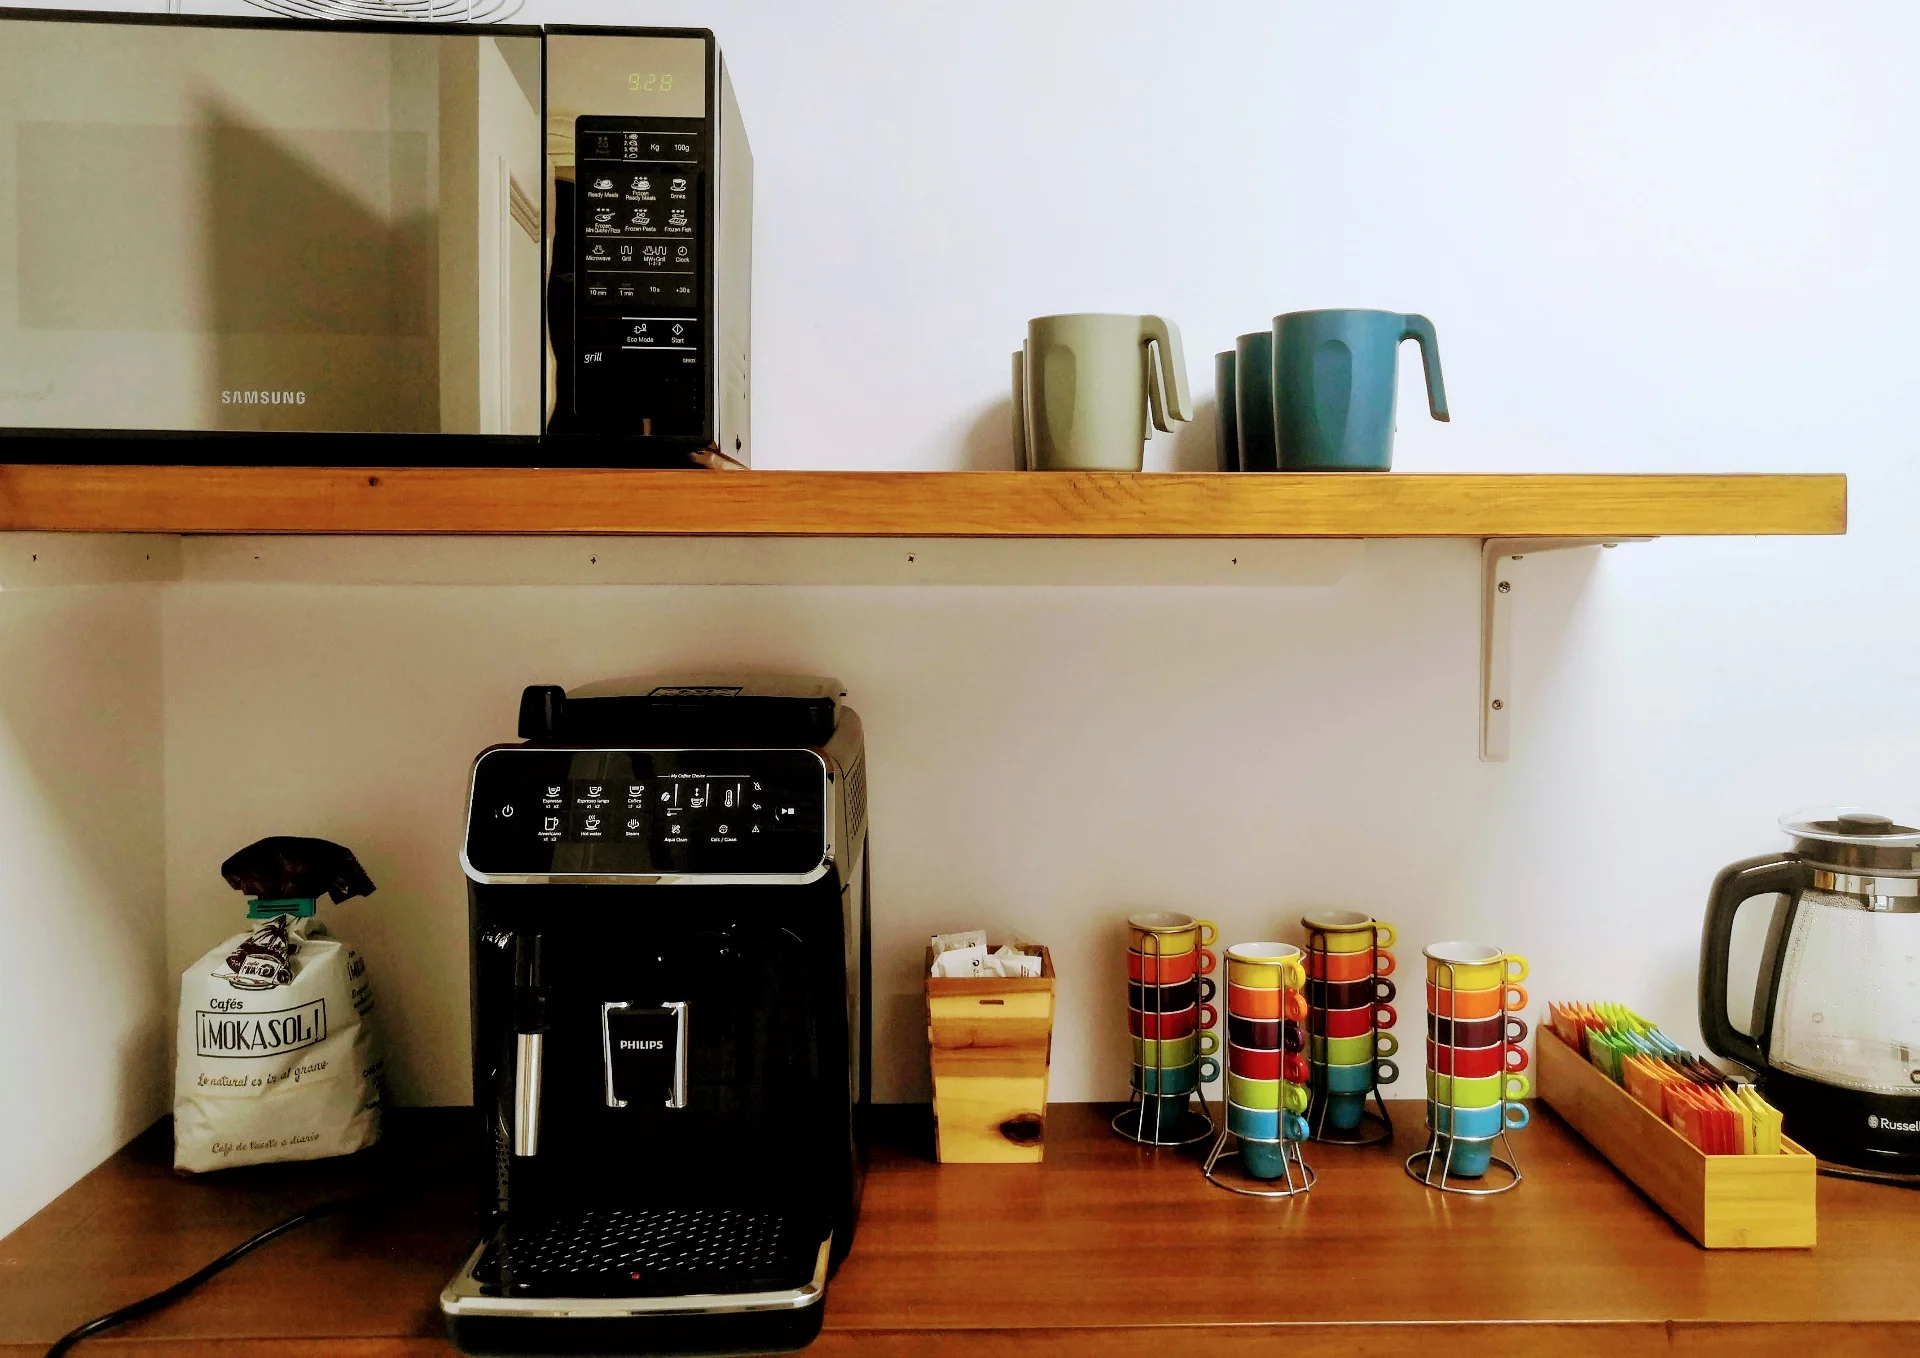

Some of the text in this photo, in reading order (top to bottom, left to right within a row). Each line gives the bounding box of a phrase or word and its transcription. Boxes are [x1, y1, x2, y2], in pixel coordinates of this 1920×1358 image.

[650, 144, 660, 152] Kg
[674, 144, 690, 152] 100g
[672, 336, 685, 344] Start
[583, 351, 603, 364] grill
[221, 390, 306, 405] SAMSUNG
[210, 998, 244, 1013] Cafés
[202, 1008, 320, 1051] ¡MOKASOL!
[620, 1040, 664, 1050] PHILIPS
[210, 1075, 248, 1087] natural
[294, 1060, 329, 1083] grano
[235, 1142, 248, 1151] de
